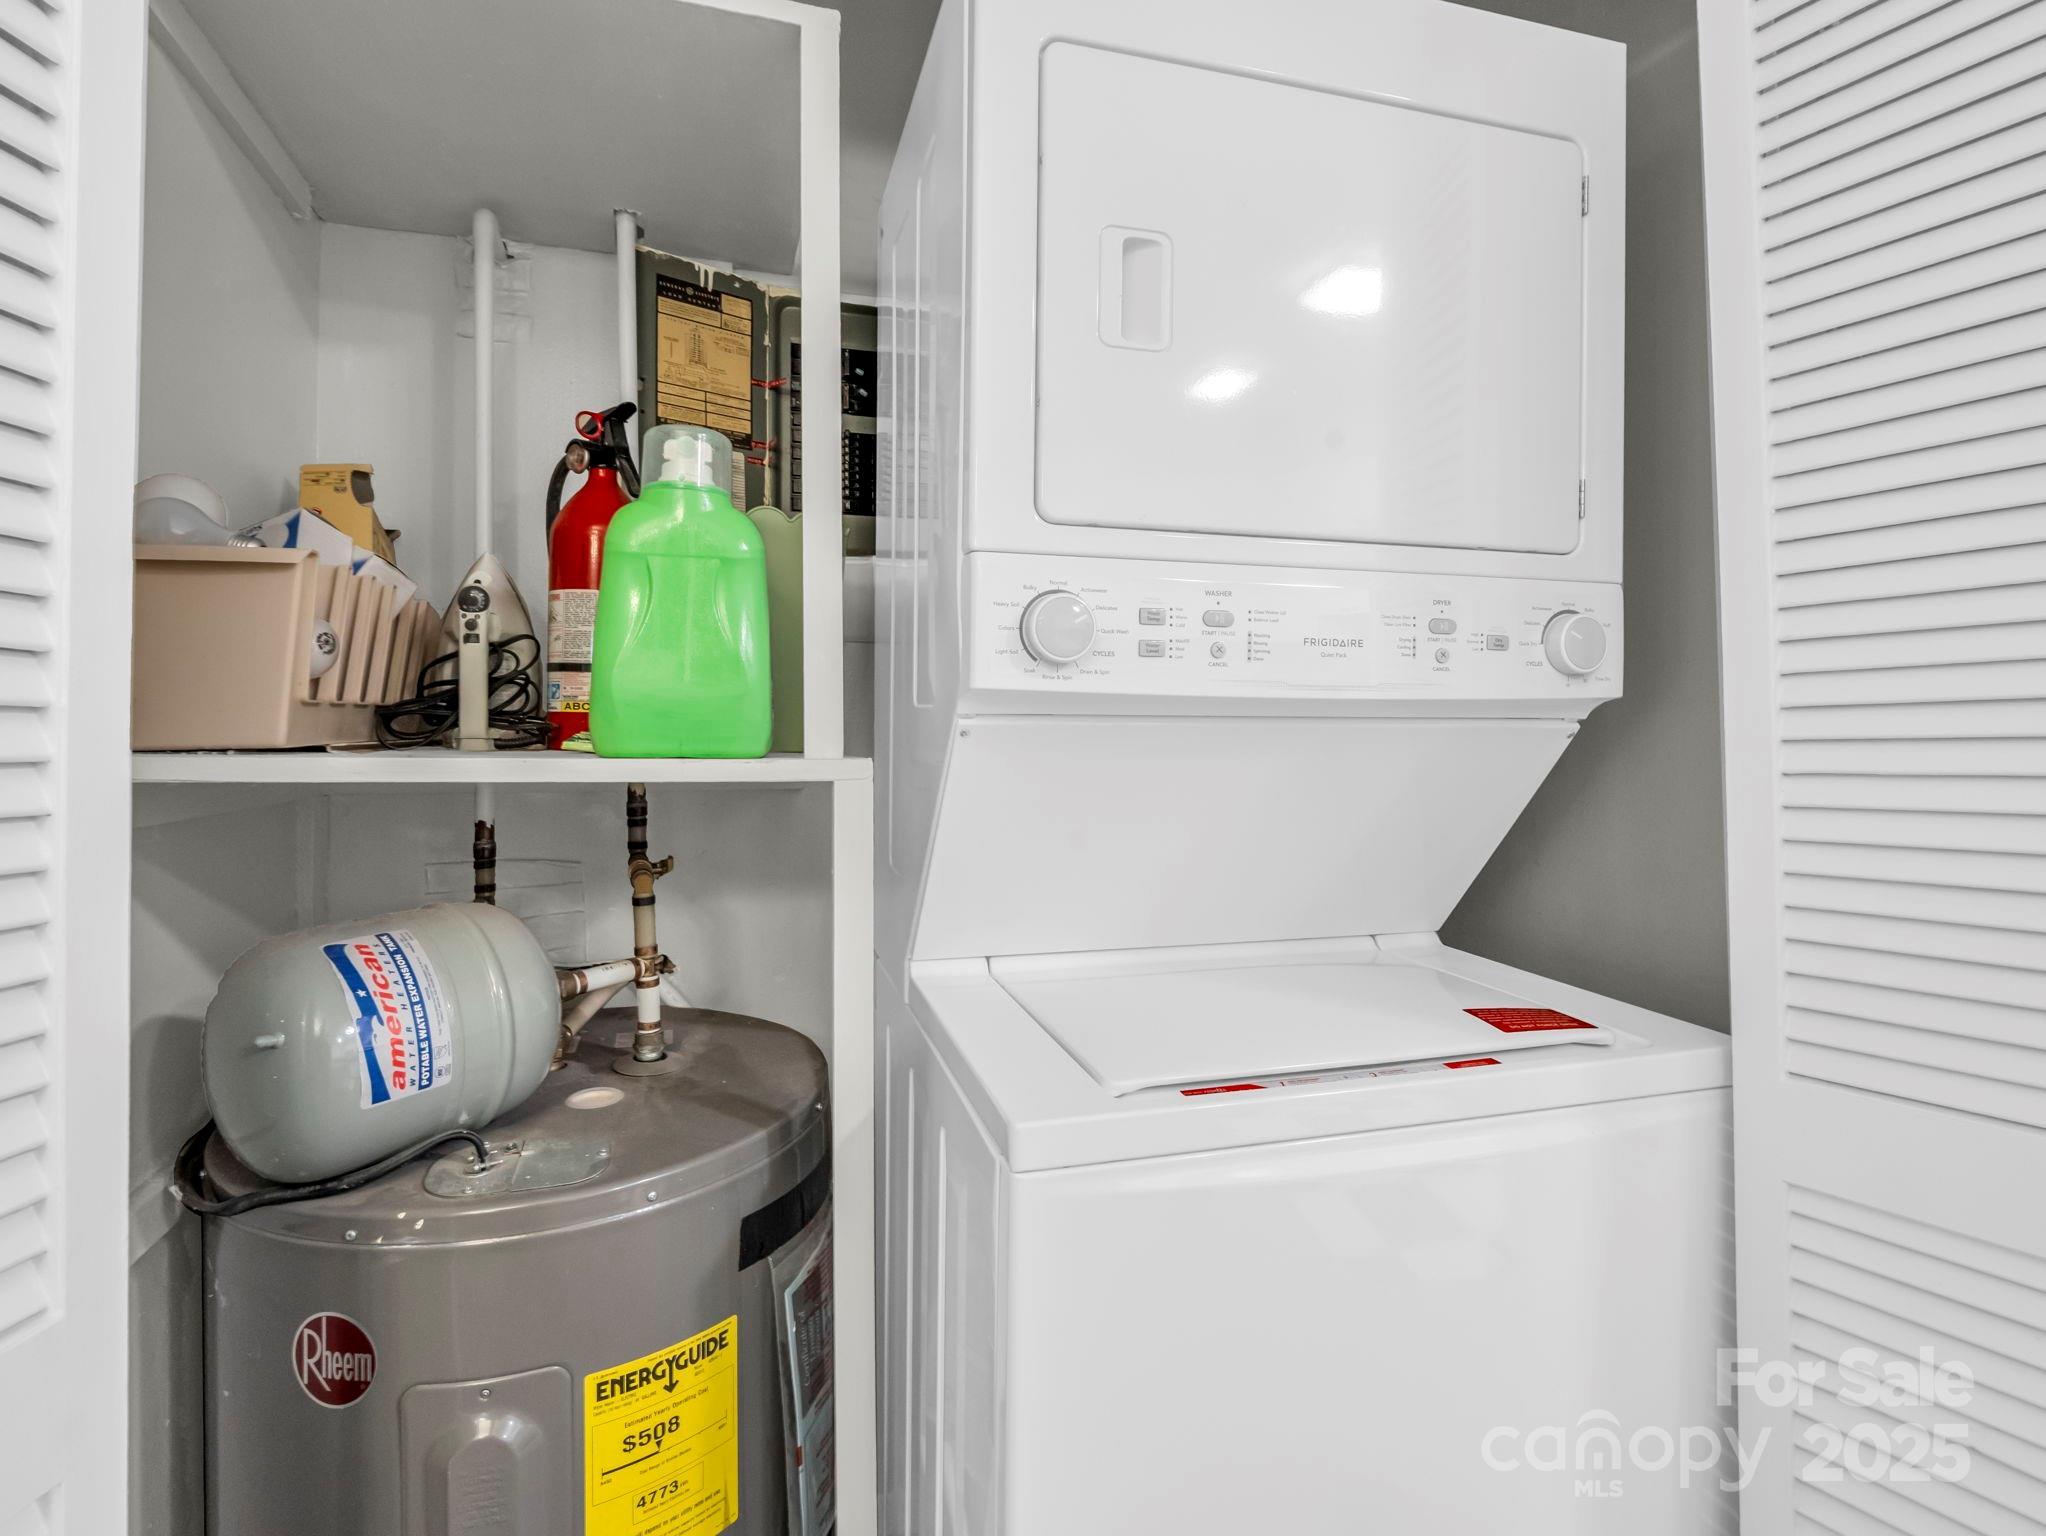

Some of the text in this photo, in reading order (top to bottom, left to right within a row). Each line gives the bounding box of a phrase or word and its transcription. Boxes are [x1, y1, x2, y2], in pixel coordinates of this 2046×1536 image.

[1303, 637, 1365, 648] FRIGIDAIRE
[564, 702, 591, 711] ABC
[354, 944, 406, 1090] american
[374, 943, 417, 1087] WATER HEATERS
[381, 935, 431, 1086] POTABLE WATER EXPANSION TANK
[303, 1316, 372, 1392] Rheem
[596, 1328, 729, 1402] ENERGYGUIDE
[622, 1415, 680, 1453] $508
[636, 1480, 679, 1508] 4773
